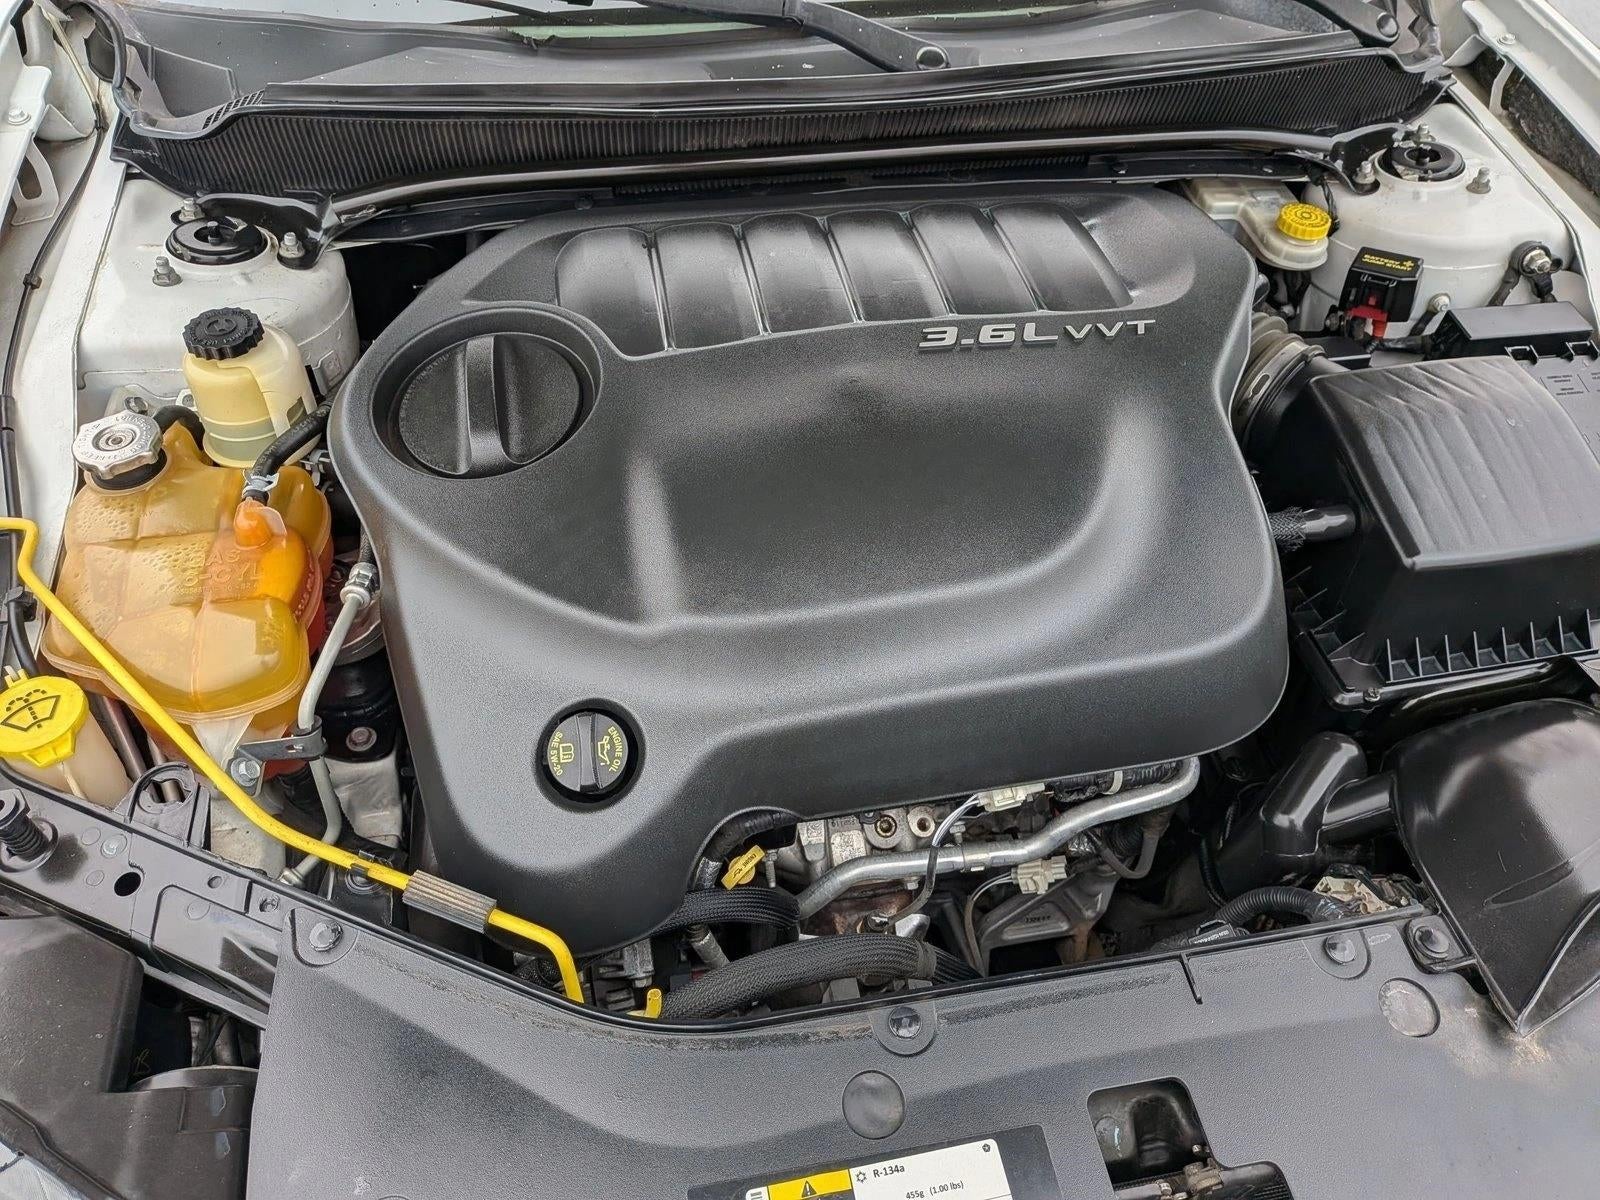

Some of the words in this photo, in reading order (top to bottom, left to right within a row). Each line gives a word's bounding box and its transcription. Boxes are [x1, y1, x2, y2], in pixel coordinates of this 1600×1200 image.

[918, 322, 1059, 350] 3.6L
[1064, 319, 1157, 341] VVT
[550, 731, 564, 748] SAE
[607, 726, 623, 758] ENGINE
[550, 749, 564, 777] 5W-20
[608, 759, 622, 773] OIL
[873, 1165, 906, 1179] R-134a
[906, 1189, 925, 1200] 455g
[929, 1183, 949, 1197] (1.00
[950, 1180, 965, 1191] lbs)
